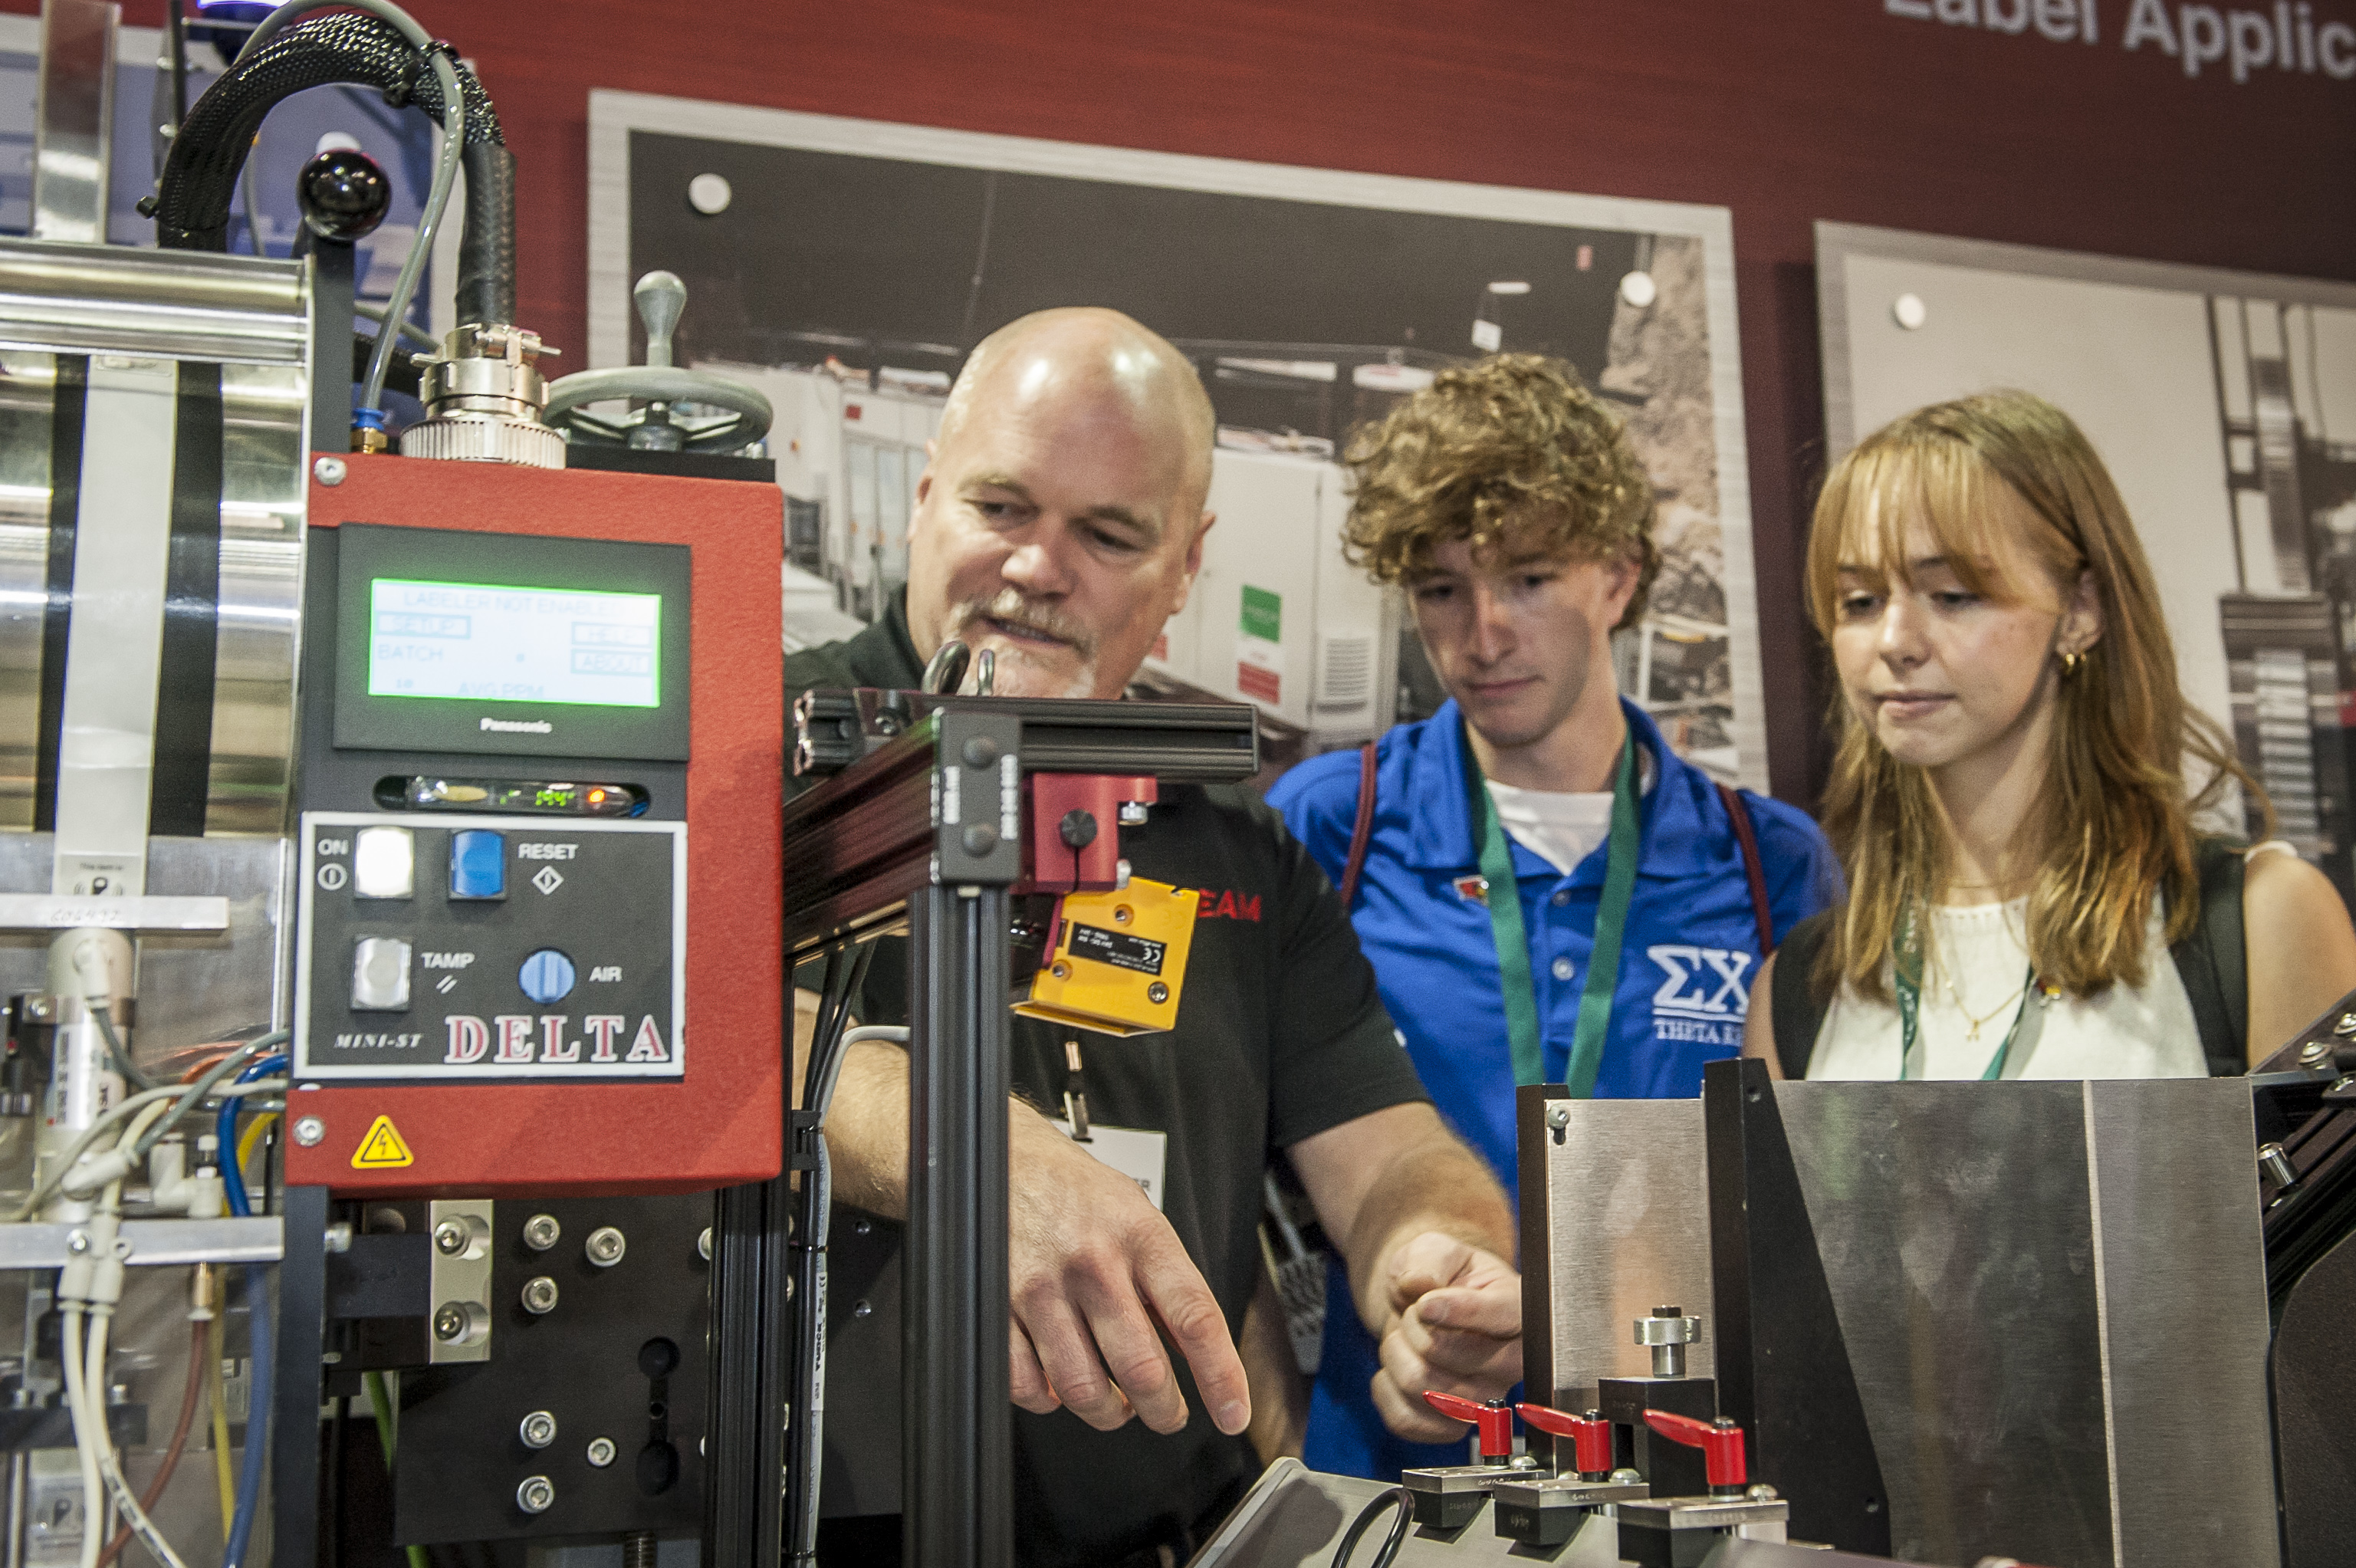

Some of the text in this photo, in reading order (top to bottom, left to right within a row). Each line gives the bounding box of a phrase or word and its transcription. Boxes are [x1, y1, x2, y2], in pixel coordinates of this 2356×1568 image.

[1884, 0, 2356, 83] abel Applic
[404, 591, 491, 610] LABELER
[495, 597, 533, 613] NOT
[392, 616, 455, 634] SETUP
[378, 643, 443, 662] BATCH
[581, 654, 643, 673] ABOUT
[479, 718, 553, 734] Panasonic
[317, 840, 349, 856] ON
[518, 843, 578, 860] RESET
[422, 952, 475, 969] TAMP
[589, 966, 623, 982] AIR
[334, 1033, 424, 1049] MINI-ST
[444, 1014, 669, 1063] DELTA
